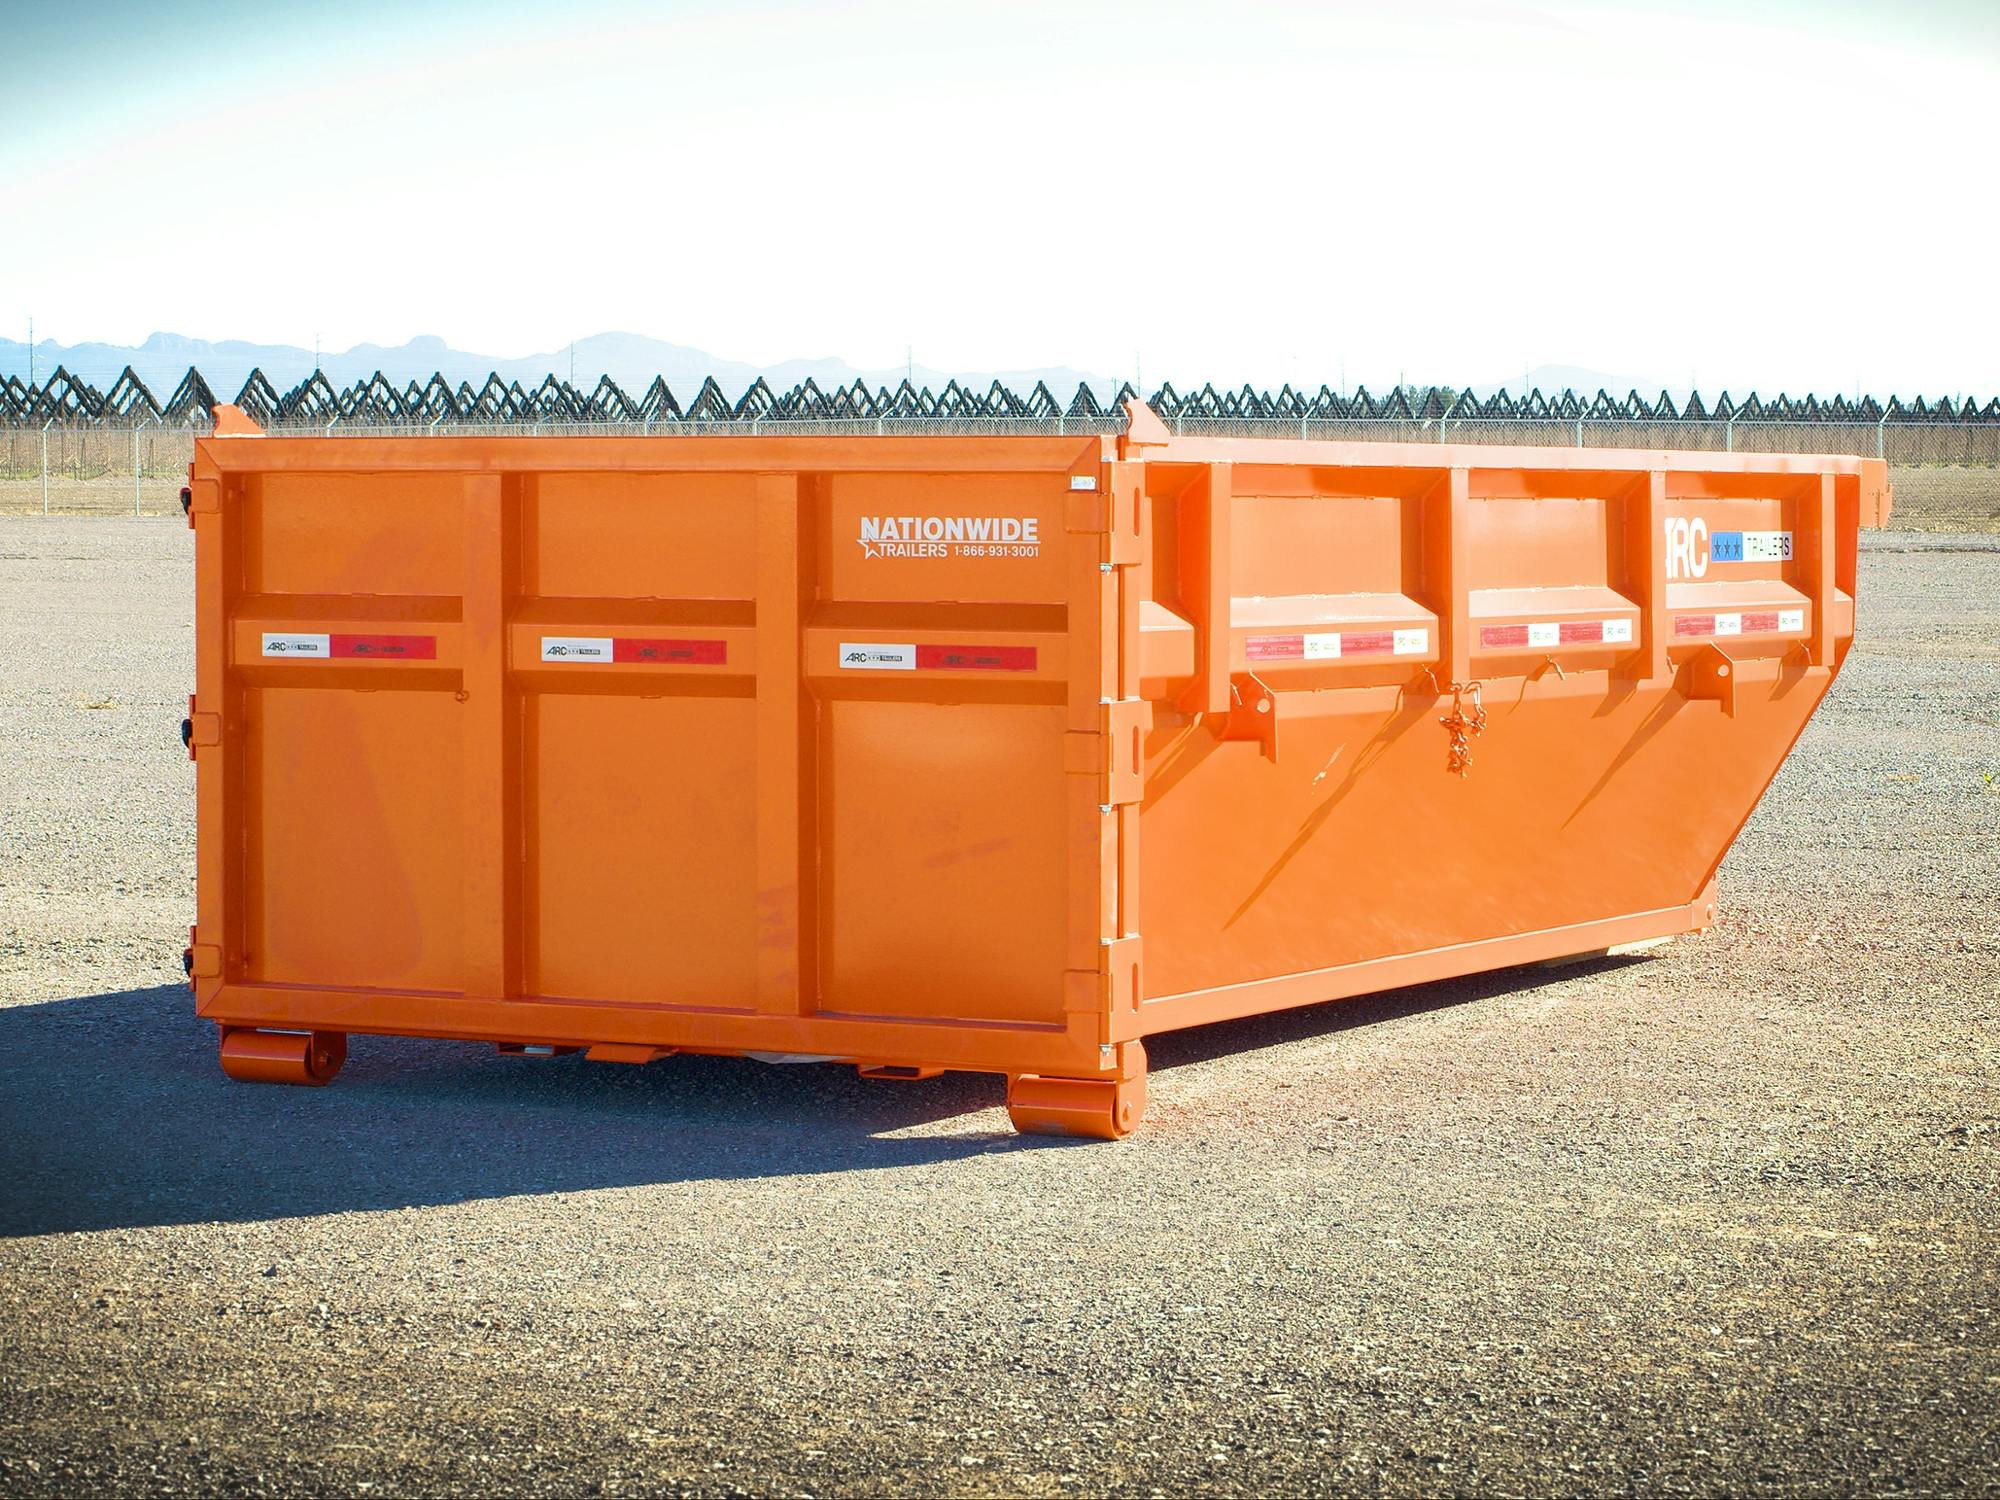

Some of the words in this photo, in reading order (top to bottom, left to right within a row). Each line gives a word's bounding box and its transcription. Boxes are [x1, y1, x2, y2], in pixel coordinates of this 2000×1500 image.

[860, 516, 1038, 541] NATIONWIDE
[878, 543, 948, 557] TRAILERS
[954, 545, 1039, 557] 1-866-931-3001
[266, 642, 286, 651] ARC
[546, 646, 567, 656] ARC
[845, 652, 867, 662] ARC
